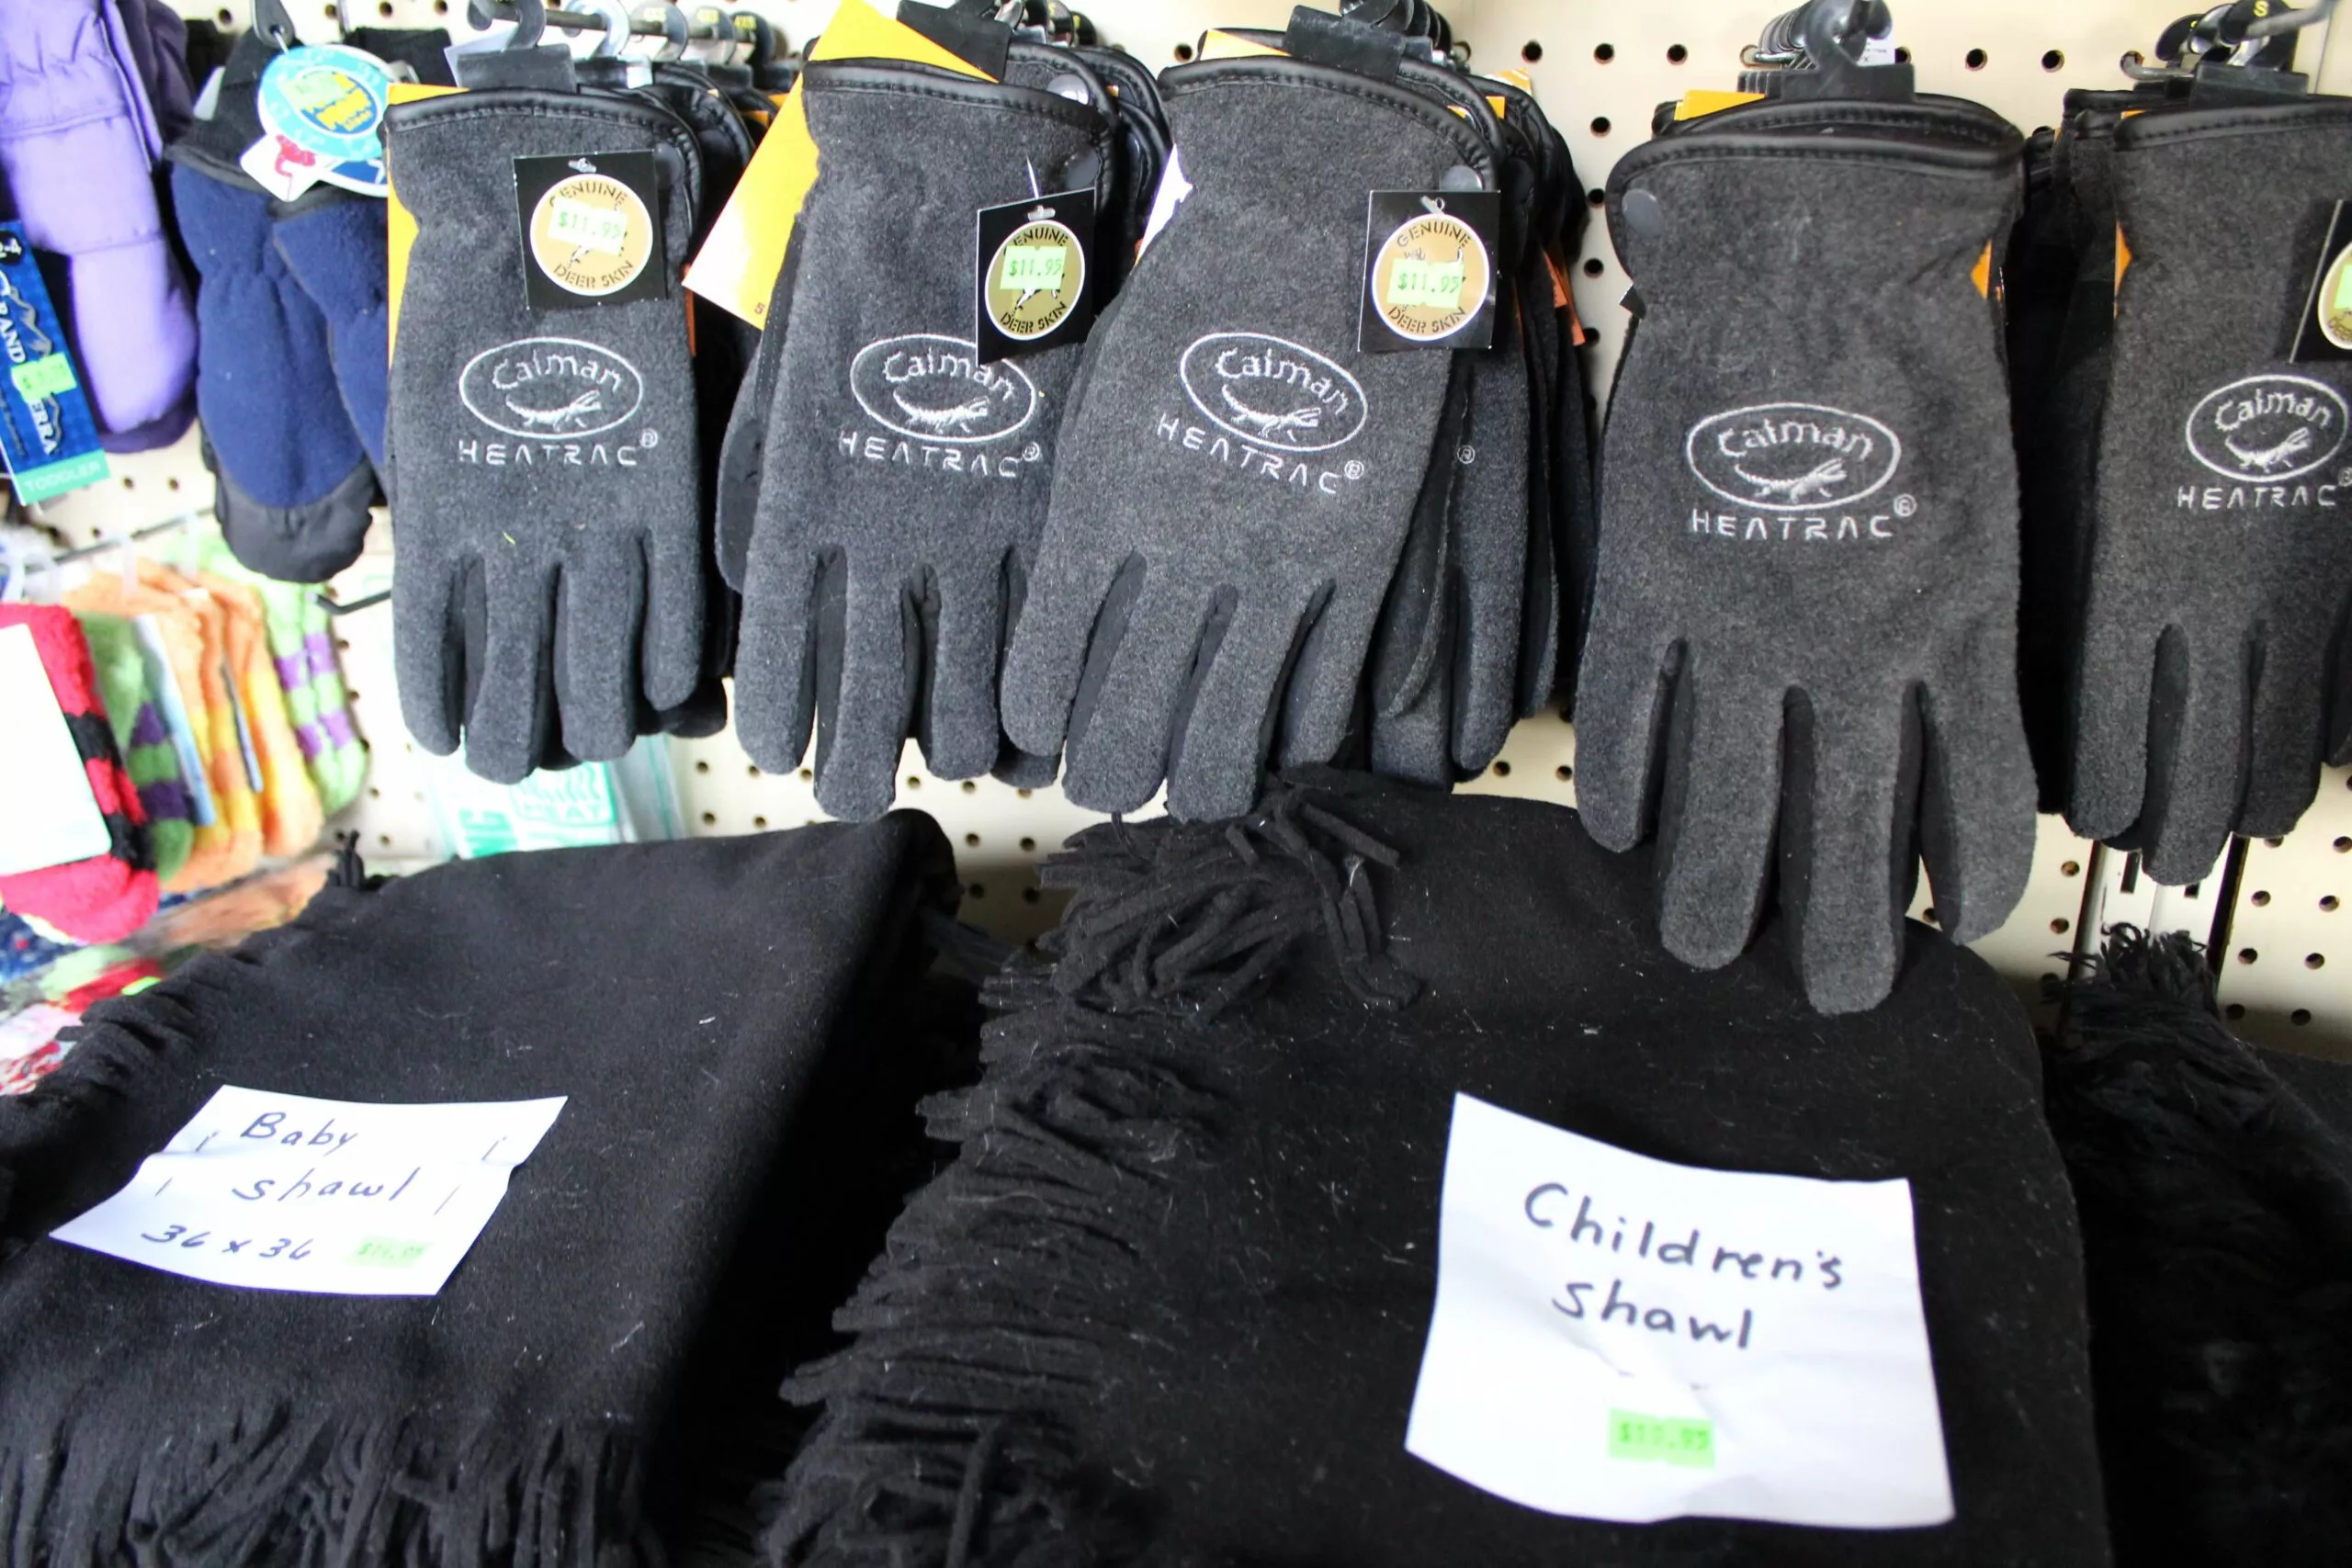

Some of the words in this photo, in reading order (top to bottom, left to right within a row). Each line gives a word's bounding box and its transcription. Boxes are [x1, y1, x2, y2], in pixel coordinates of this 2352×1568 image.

[1007, 227, 1069, 251] ENUINE
[1396, 221, 1472, 248] GENUINE
[554, 264, 596, 288] DEER
[601, 260, 634, 288] SKIN
[1010, 258, 1063, 277] $11.95
[1397, 273, 1460, 294] $11.95
[1000, 312, 1034, 333] DEER
[1038, 301, 1067, 330] SKIN
[1388, 306, 1427, 333] DEER
[1431, 307, 1465, 333] SKIN
[492, 349, 624, 393] Caiman
[882, 346, 1018, 401] Caiman
[1215, 347, 1351, 417] Caiman
[28, 397, 58, 456] ERRA
[2214, 388, 2334, 432] Caiman
[1717, 418, 1874, 460] Caiman
[240, 1111, 359, 1157] Baby
[141, 1224, 212, 1248] 36
[258, 1238, 313, 1261] 36
[1523, 1182, 1844, 1291] Children's
